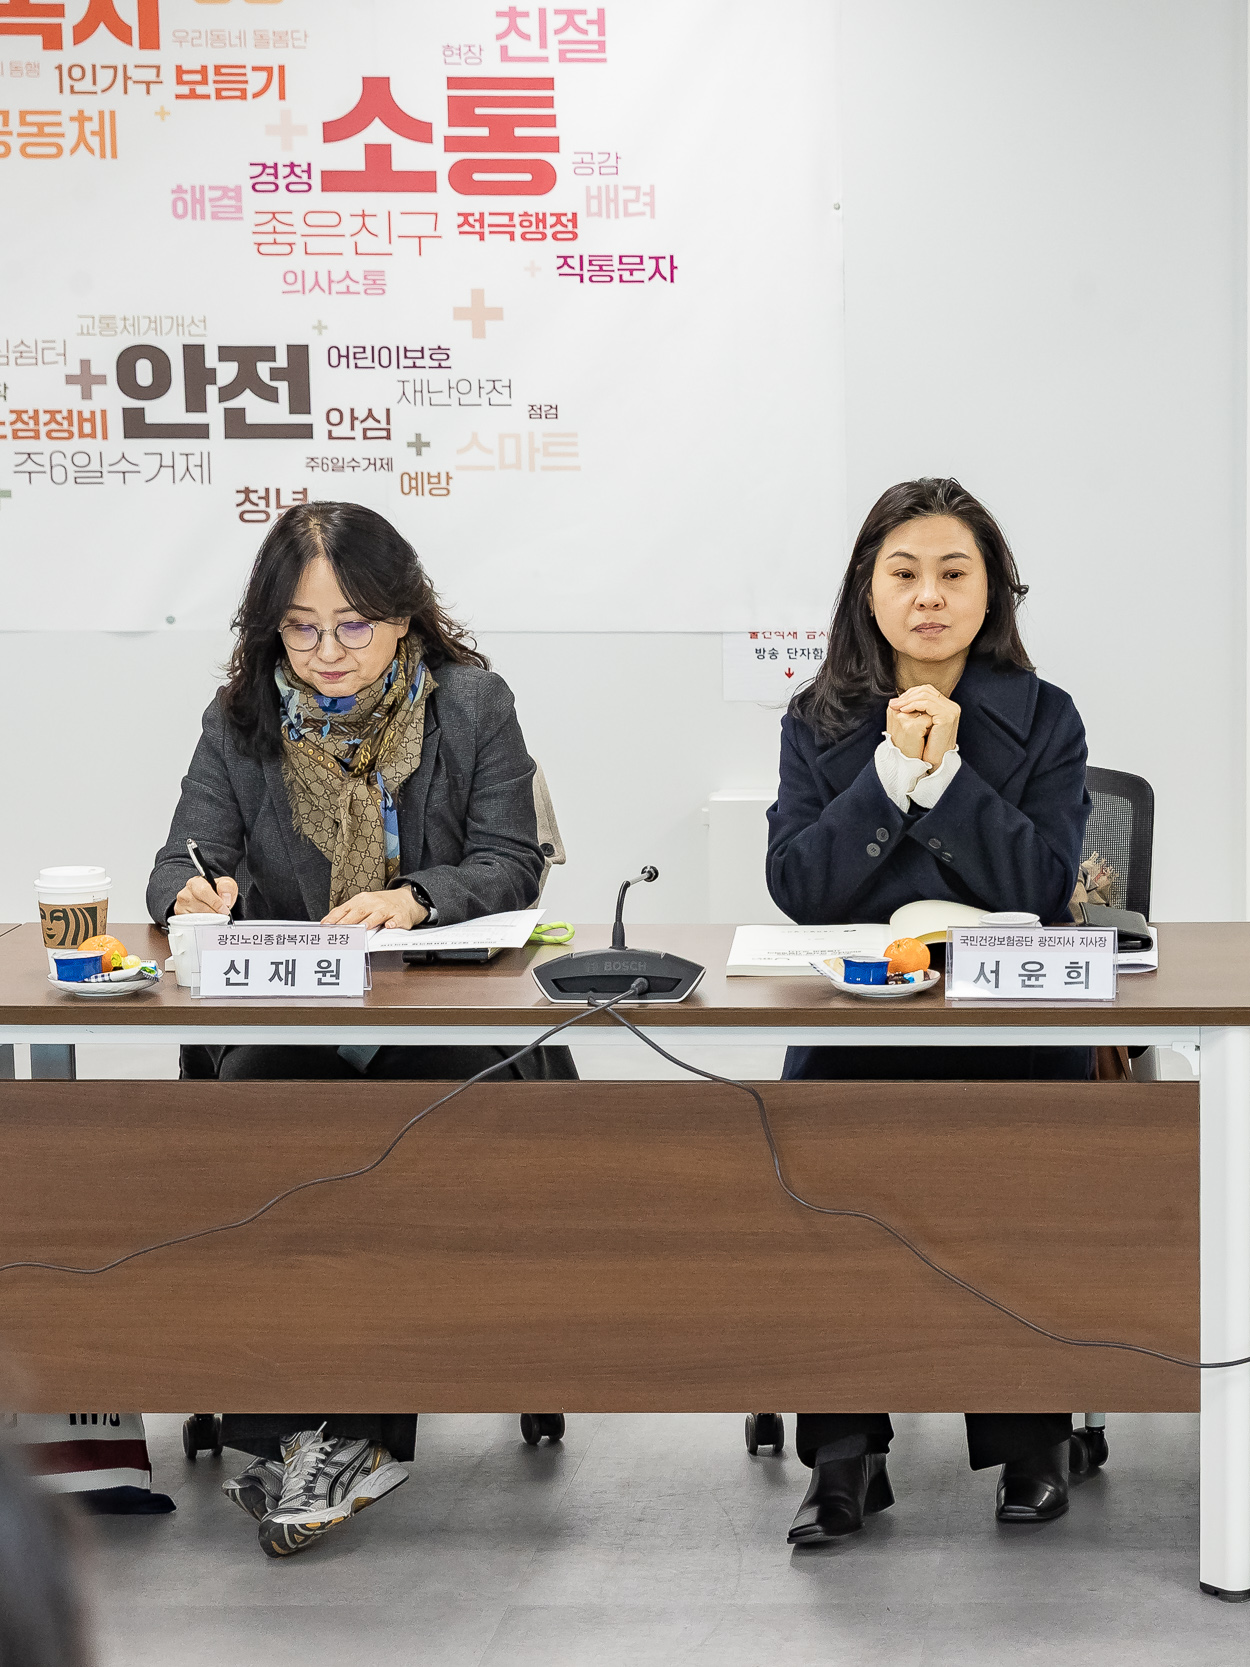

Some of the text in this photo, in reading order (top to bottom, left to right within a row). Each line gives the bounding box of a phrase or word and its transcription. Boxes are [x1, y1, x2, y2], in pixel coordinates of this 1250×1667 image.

[171, 29, 309, 49] 우리동네 돌봄단
[496, 6, 607, 63] 친절
[442, 43, 484, 66] 현장
[54, 63, 286, 100] 1인가구 보듬기
[321, 76, 560, 196] 소통
[249, 161, 313, 193] 경청
[571, 151, 622, 176] 공감
[171, 184, 244, 221] 해결
[585, 184, 656, 219] 배려
[252, 209, 443, 256] 좋은친구
[457, 211, 579, 242] 적극행정
[282, 269, 388, 296] 의사소통
[556, 254, 678, 284] 직통문자
[76, 314, 208, 337] 교통체계개선
[328, 345, 452, 370] 어린이보호
[116, 344, 314, 440] 안전
[396, 378, 513, 407] 재난안전
[0, 409, 109, 441] 점정비
[325, 407, 392, 441] 안심
[527, 404, 559, 420] 점검
[305, 457, 394, 473] 주6일수거제
[455, 431, 582, 473] 스마트
[13, 450, 212, 486] 주6일수거제
[400, 471, 454, 497] 예방
[755, 647, 824, 660] 방송 단자함
[217, 934, 350, 946] 광진노인종합복지관 관장
[959, 935, 1107, 948] 국민건강보험공단 광진지사 지사장
[603, 961, 648, 972] BOSCH
